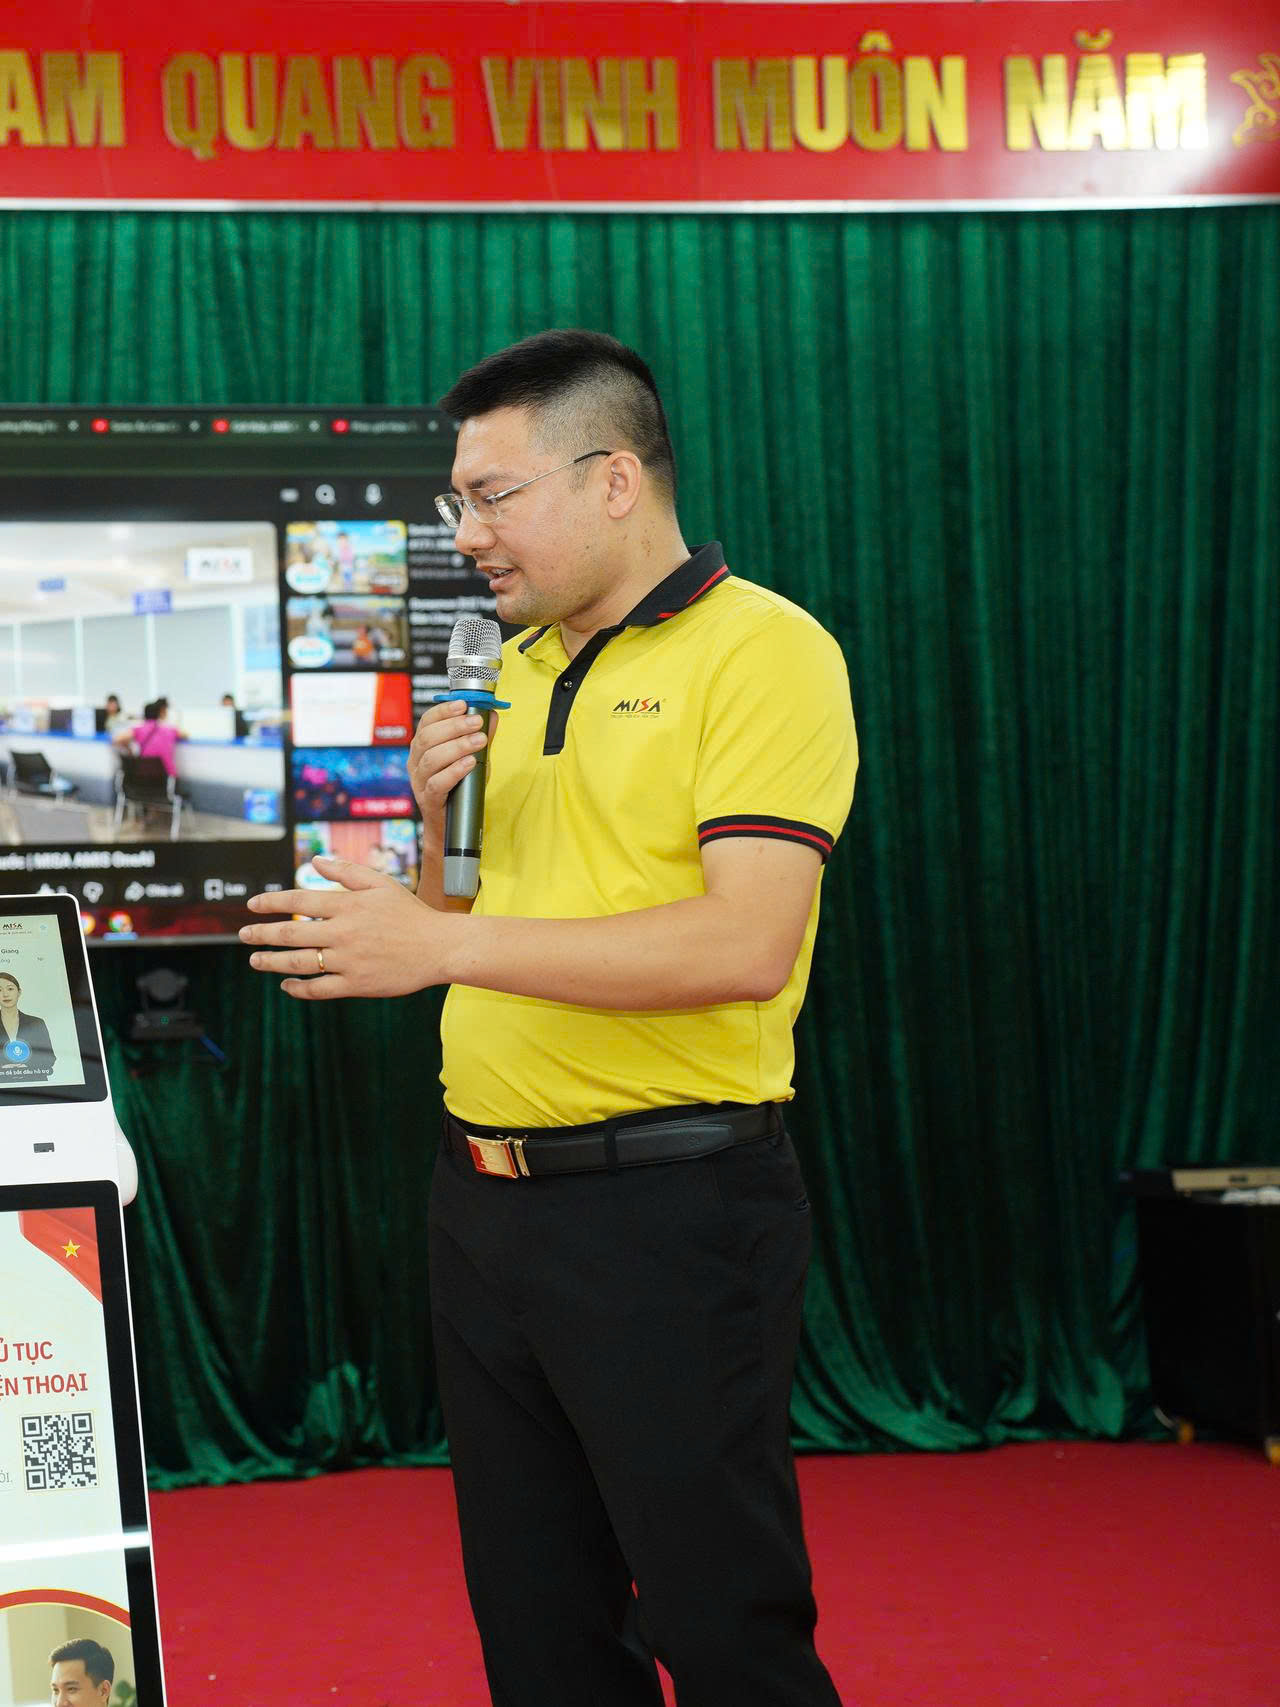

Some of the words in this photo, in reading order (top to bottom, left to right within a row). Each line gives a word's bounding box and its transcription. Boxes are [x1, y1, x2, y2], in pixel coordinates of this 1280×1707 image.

[161, 51, 455, 159] QUANG
[480, 55, 680, 151] VINH
[713, 30, 968, 152] MUÔN
[1004, 28, 1209, 152] NĂM
[612, 697, 661, 713] MISA
[1, 947, 19, 956] Giang
[13, 1341, 53, 1366] TỤC
[23, 1372, 88, 1397] THOẠI
